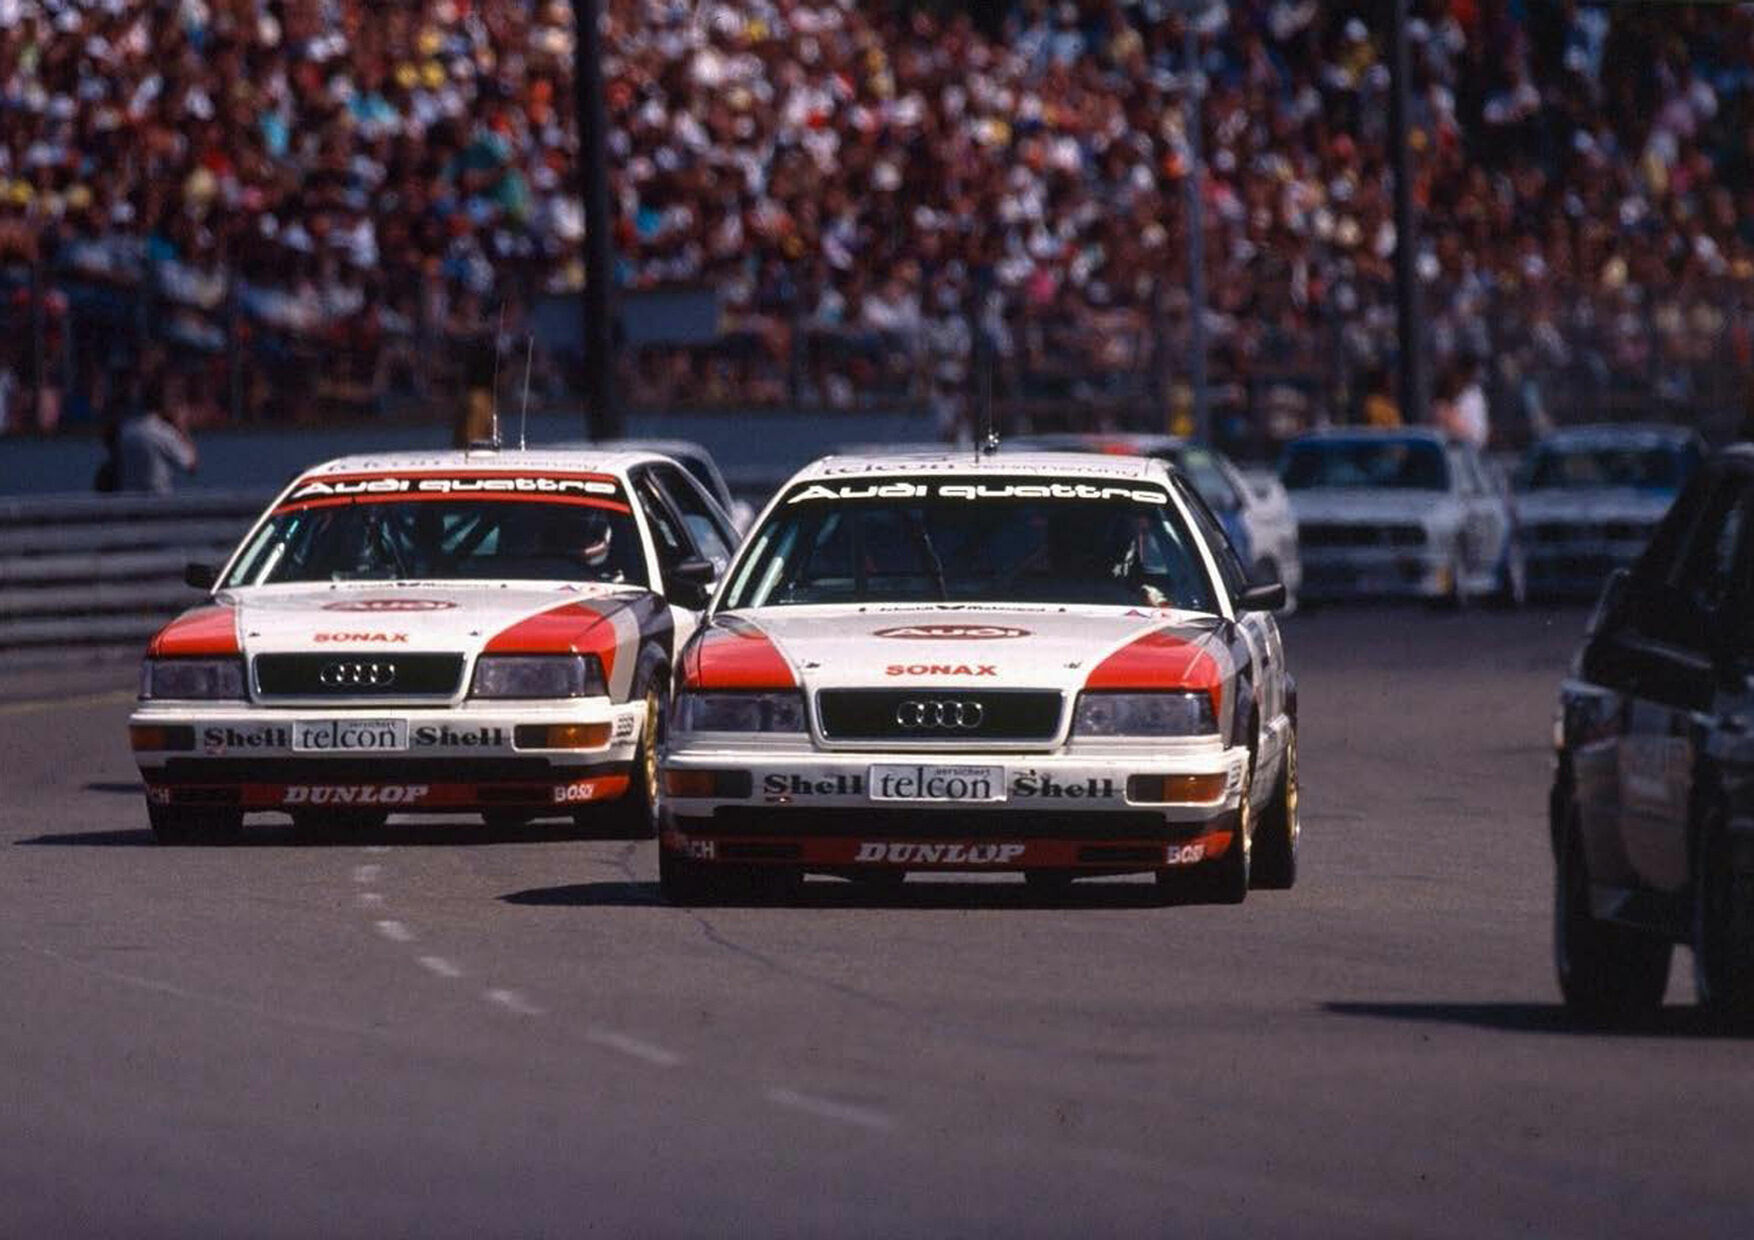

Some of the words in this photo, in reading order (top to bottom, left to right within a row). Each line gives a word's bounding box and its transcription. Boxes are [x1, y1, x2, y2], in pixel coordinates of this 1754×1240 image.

[291, 478, 410, 497] Audi
[418, 479, 616, 495] quattro
[788, 482, 928, 504] Audi
[938, 483, 1167, 504] quattro
[313, 633, 409, 643] SONAX
[885, 665, 997, 676] SONAX
[204, 727, 286, 748] Shell
[302, 721, 397, 749] telcon
[415, 726, 502, 747] Shell
[764, 774, 862, 795] Shell
[880, 767, 991, 799] telcon
[1013, 776, 1113, 798] Shell
[283, 785, 429, 803] DUNLOP
[855, 842, 1026, 863] DUNLOP
